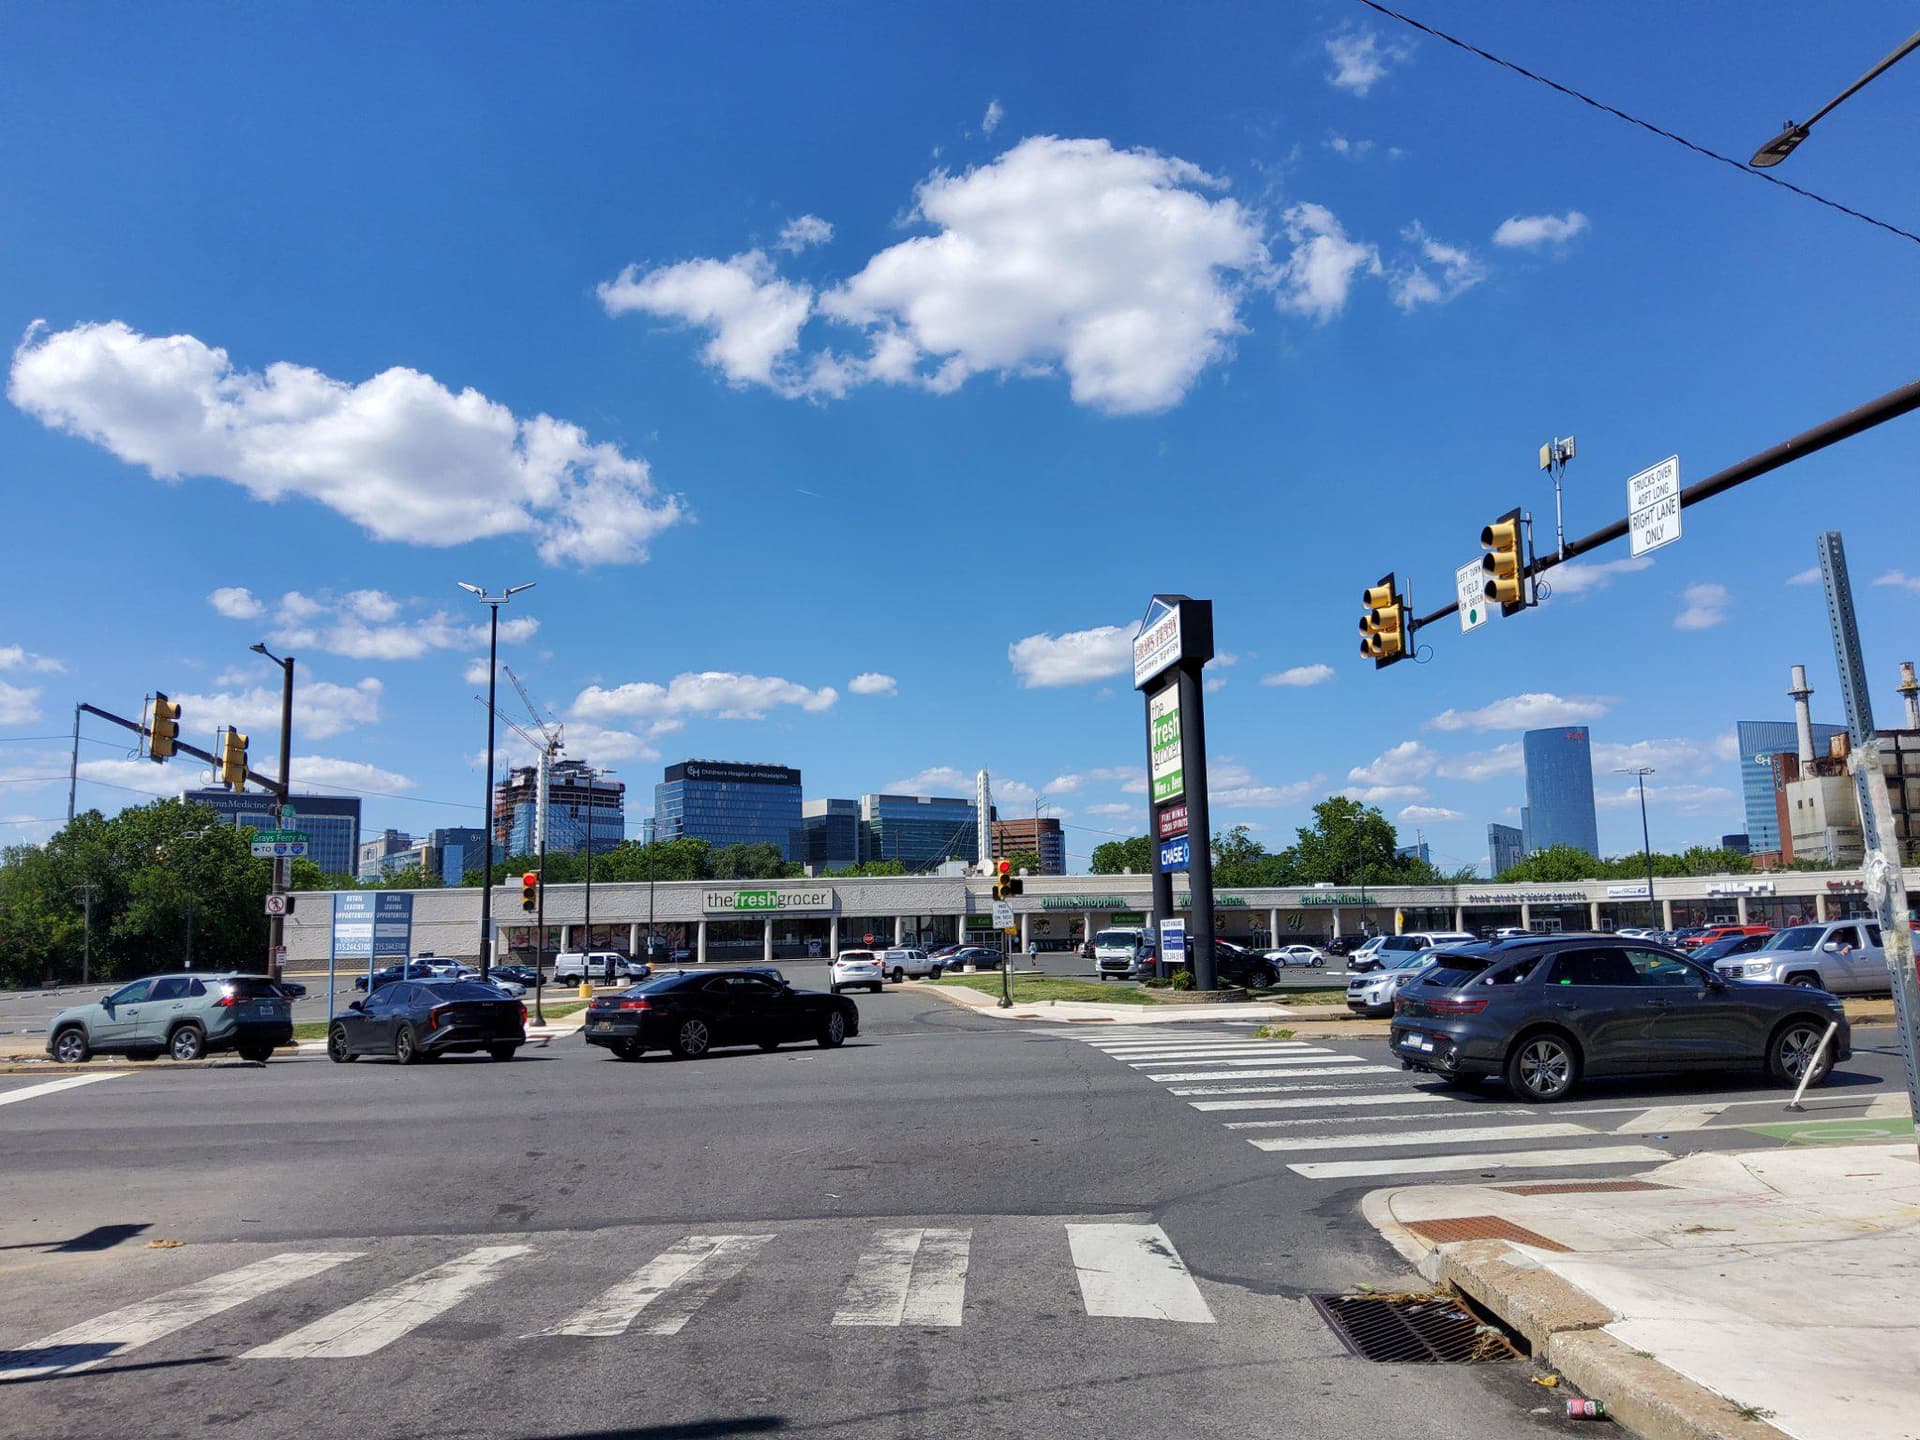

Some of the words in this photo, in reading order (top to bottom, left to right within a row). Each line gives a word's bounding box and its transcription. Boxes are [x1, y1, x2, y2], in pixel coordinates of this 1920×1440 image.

[1634, 472, 1655, 493] TRUCKS
[1656, 465, 1672, 482] OVER
[1638, 490, 1651, 505] 40FT
[1653, 482, 1669, 499] LONG
[1633, 506, 1655, 530] RIGHT
[1656, 498, 1676, 520] LANE
[1645, 523, 1664, 545] ONLY
[1458, 571, 1468, 583] LEFT
[1463, 580, 1480, 596] YIELD
[1153, 711, 1180, 748] fresh
[206, 799, 228, 809] Penn
[228, 799, 267, 809] Medicine
[253, 833, 274, 844] Grays
[277, 834, 296, 844] Ferry
[1161, 846, 1183, 866] CHASE
[1041, 895, 1073, 907] Online
[1075, 895, 1126, 908] Shopping
